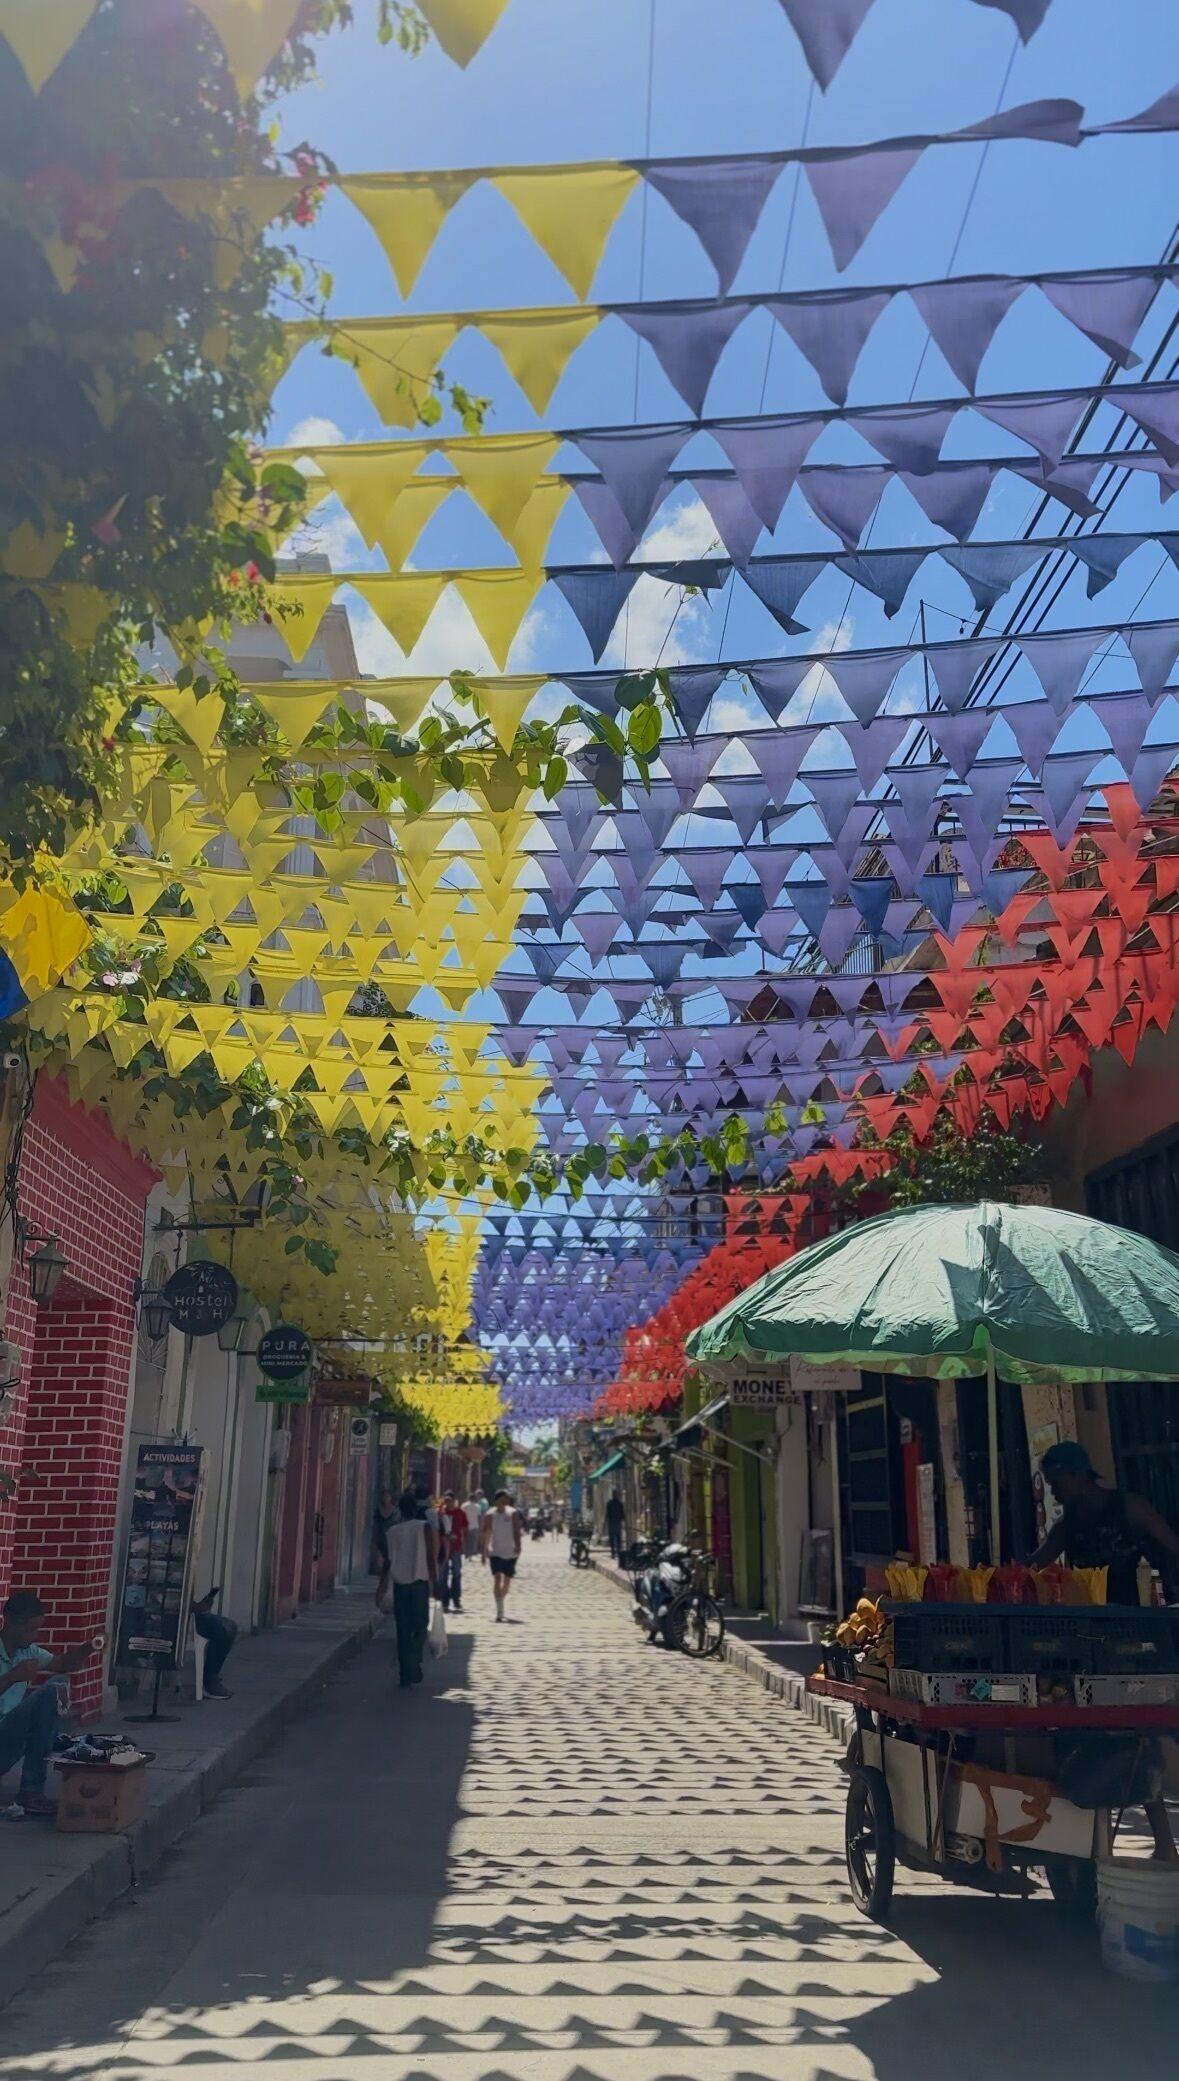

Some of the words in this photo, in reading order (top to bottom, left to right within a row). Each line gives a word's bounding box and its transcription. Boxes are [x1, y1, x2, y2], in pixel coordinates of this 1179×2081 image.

[262, 1341, 310, 1351] PURA
[733, 1395, 801, 1405] EXCHANGE
[143, 1453, 196, 1463] ACTIVIDADES
[145, 1521, 179, 1530] PLAYAS
